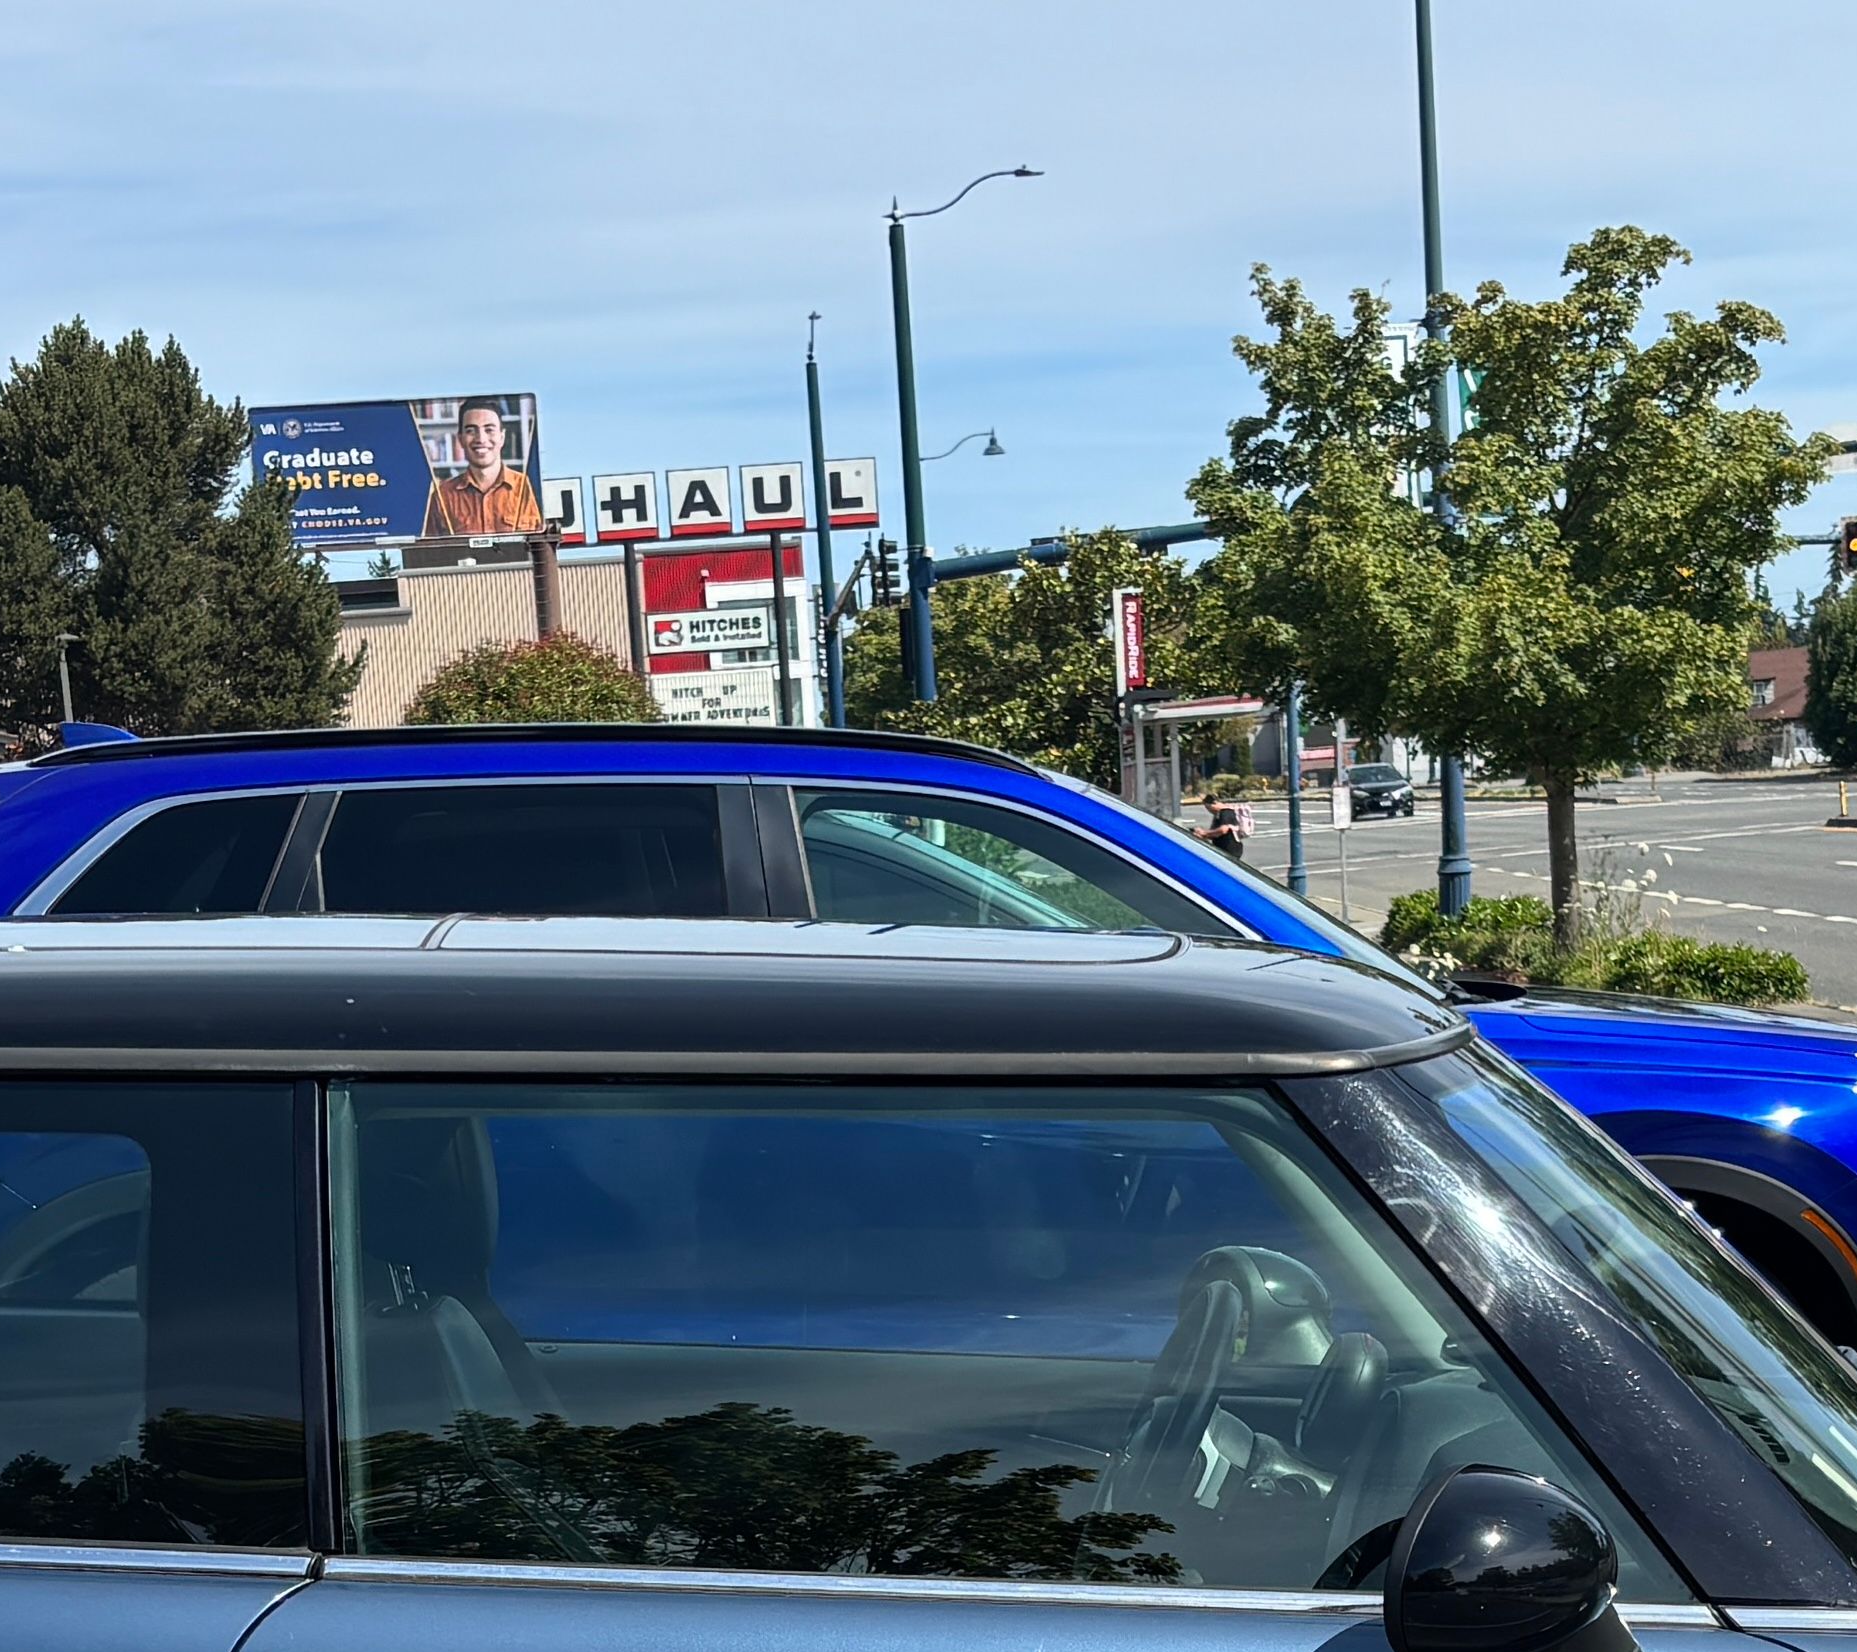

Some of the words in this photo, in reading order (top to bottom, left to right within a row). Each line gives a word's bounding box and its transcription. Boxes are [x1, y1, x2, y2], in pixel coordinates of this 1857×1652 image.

[263, 447, 374, 469] Graduate
[268, 471, 322, 491] ebt
[328, 469, 386, 488] Free.
[689, 616, 762, 634] HITCHES
[671, 686, 704, 699] HITCH
[722, 684, 737, 696] UP
[701, 697, 722, 709] FOR
[661, 711, 701, 724] UMMER
